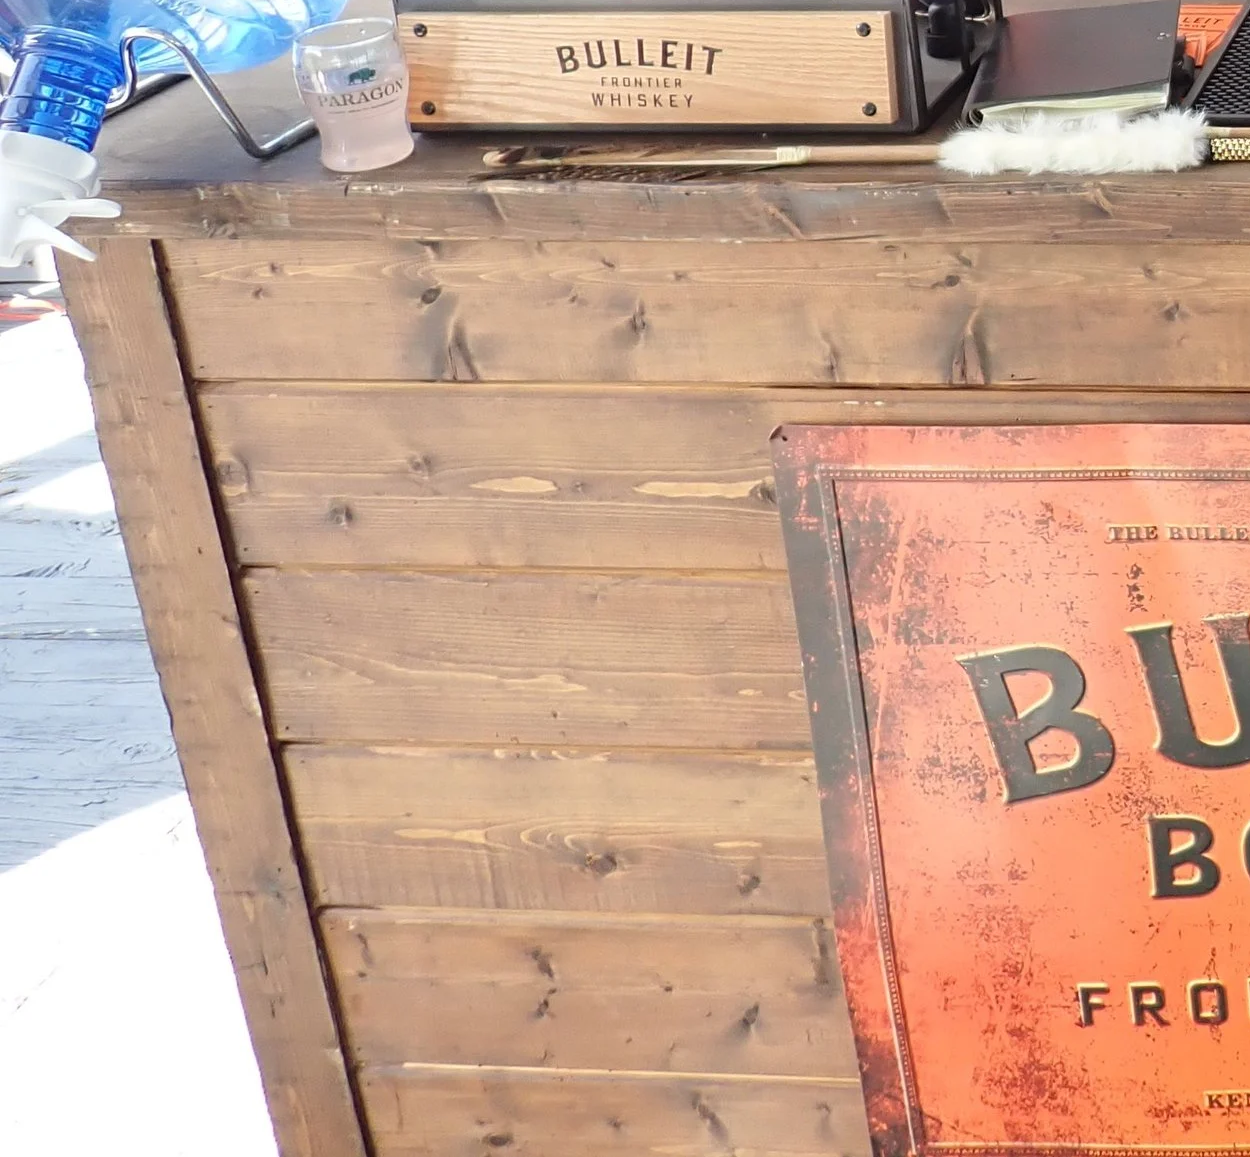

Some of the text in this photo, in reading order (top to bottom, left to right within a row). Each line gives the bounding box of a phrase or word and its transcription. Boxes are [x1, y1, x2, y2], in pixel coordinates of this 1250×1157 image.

[555, 39, 723, 76] BULLEIT
[601, 77, 682, 88] FRONTIER
[317, 77, 403, 108] PARAGON
[591, 92, 693, 108] WHISKEY
[1108, 525, 1158, 542] THE
